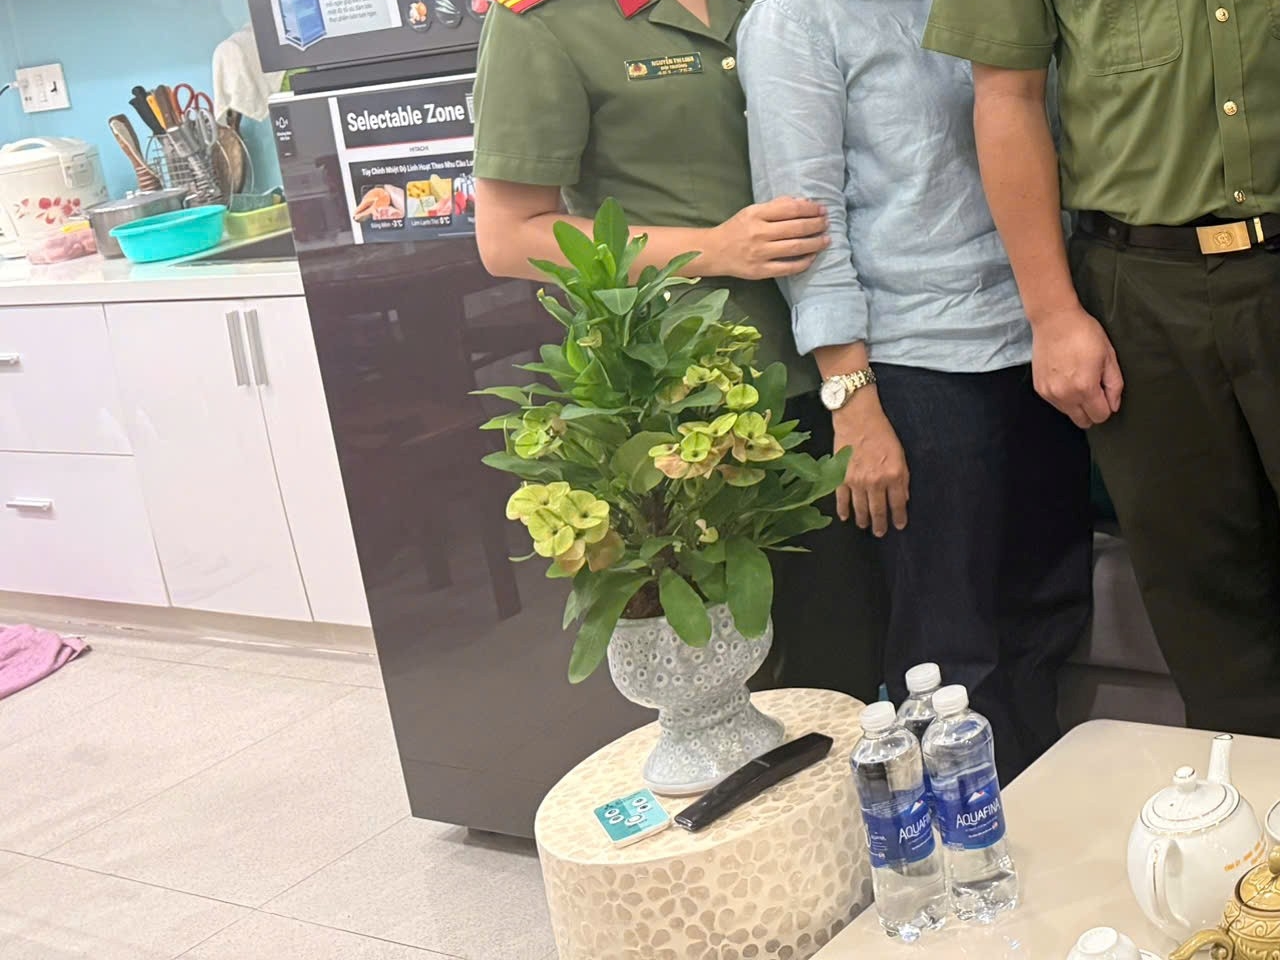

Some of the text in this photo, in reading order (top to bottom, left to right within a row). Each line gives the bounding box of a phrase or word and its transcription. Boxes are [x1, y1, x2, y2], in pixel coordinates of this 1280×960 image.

[346, 104, 465, 132] Selectable Zone
[956, 798, 1000, 828] AQUAFINA
